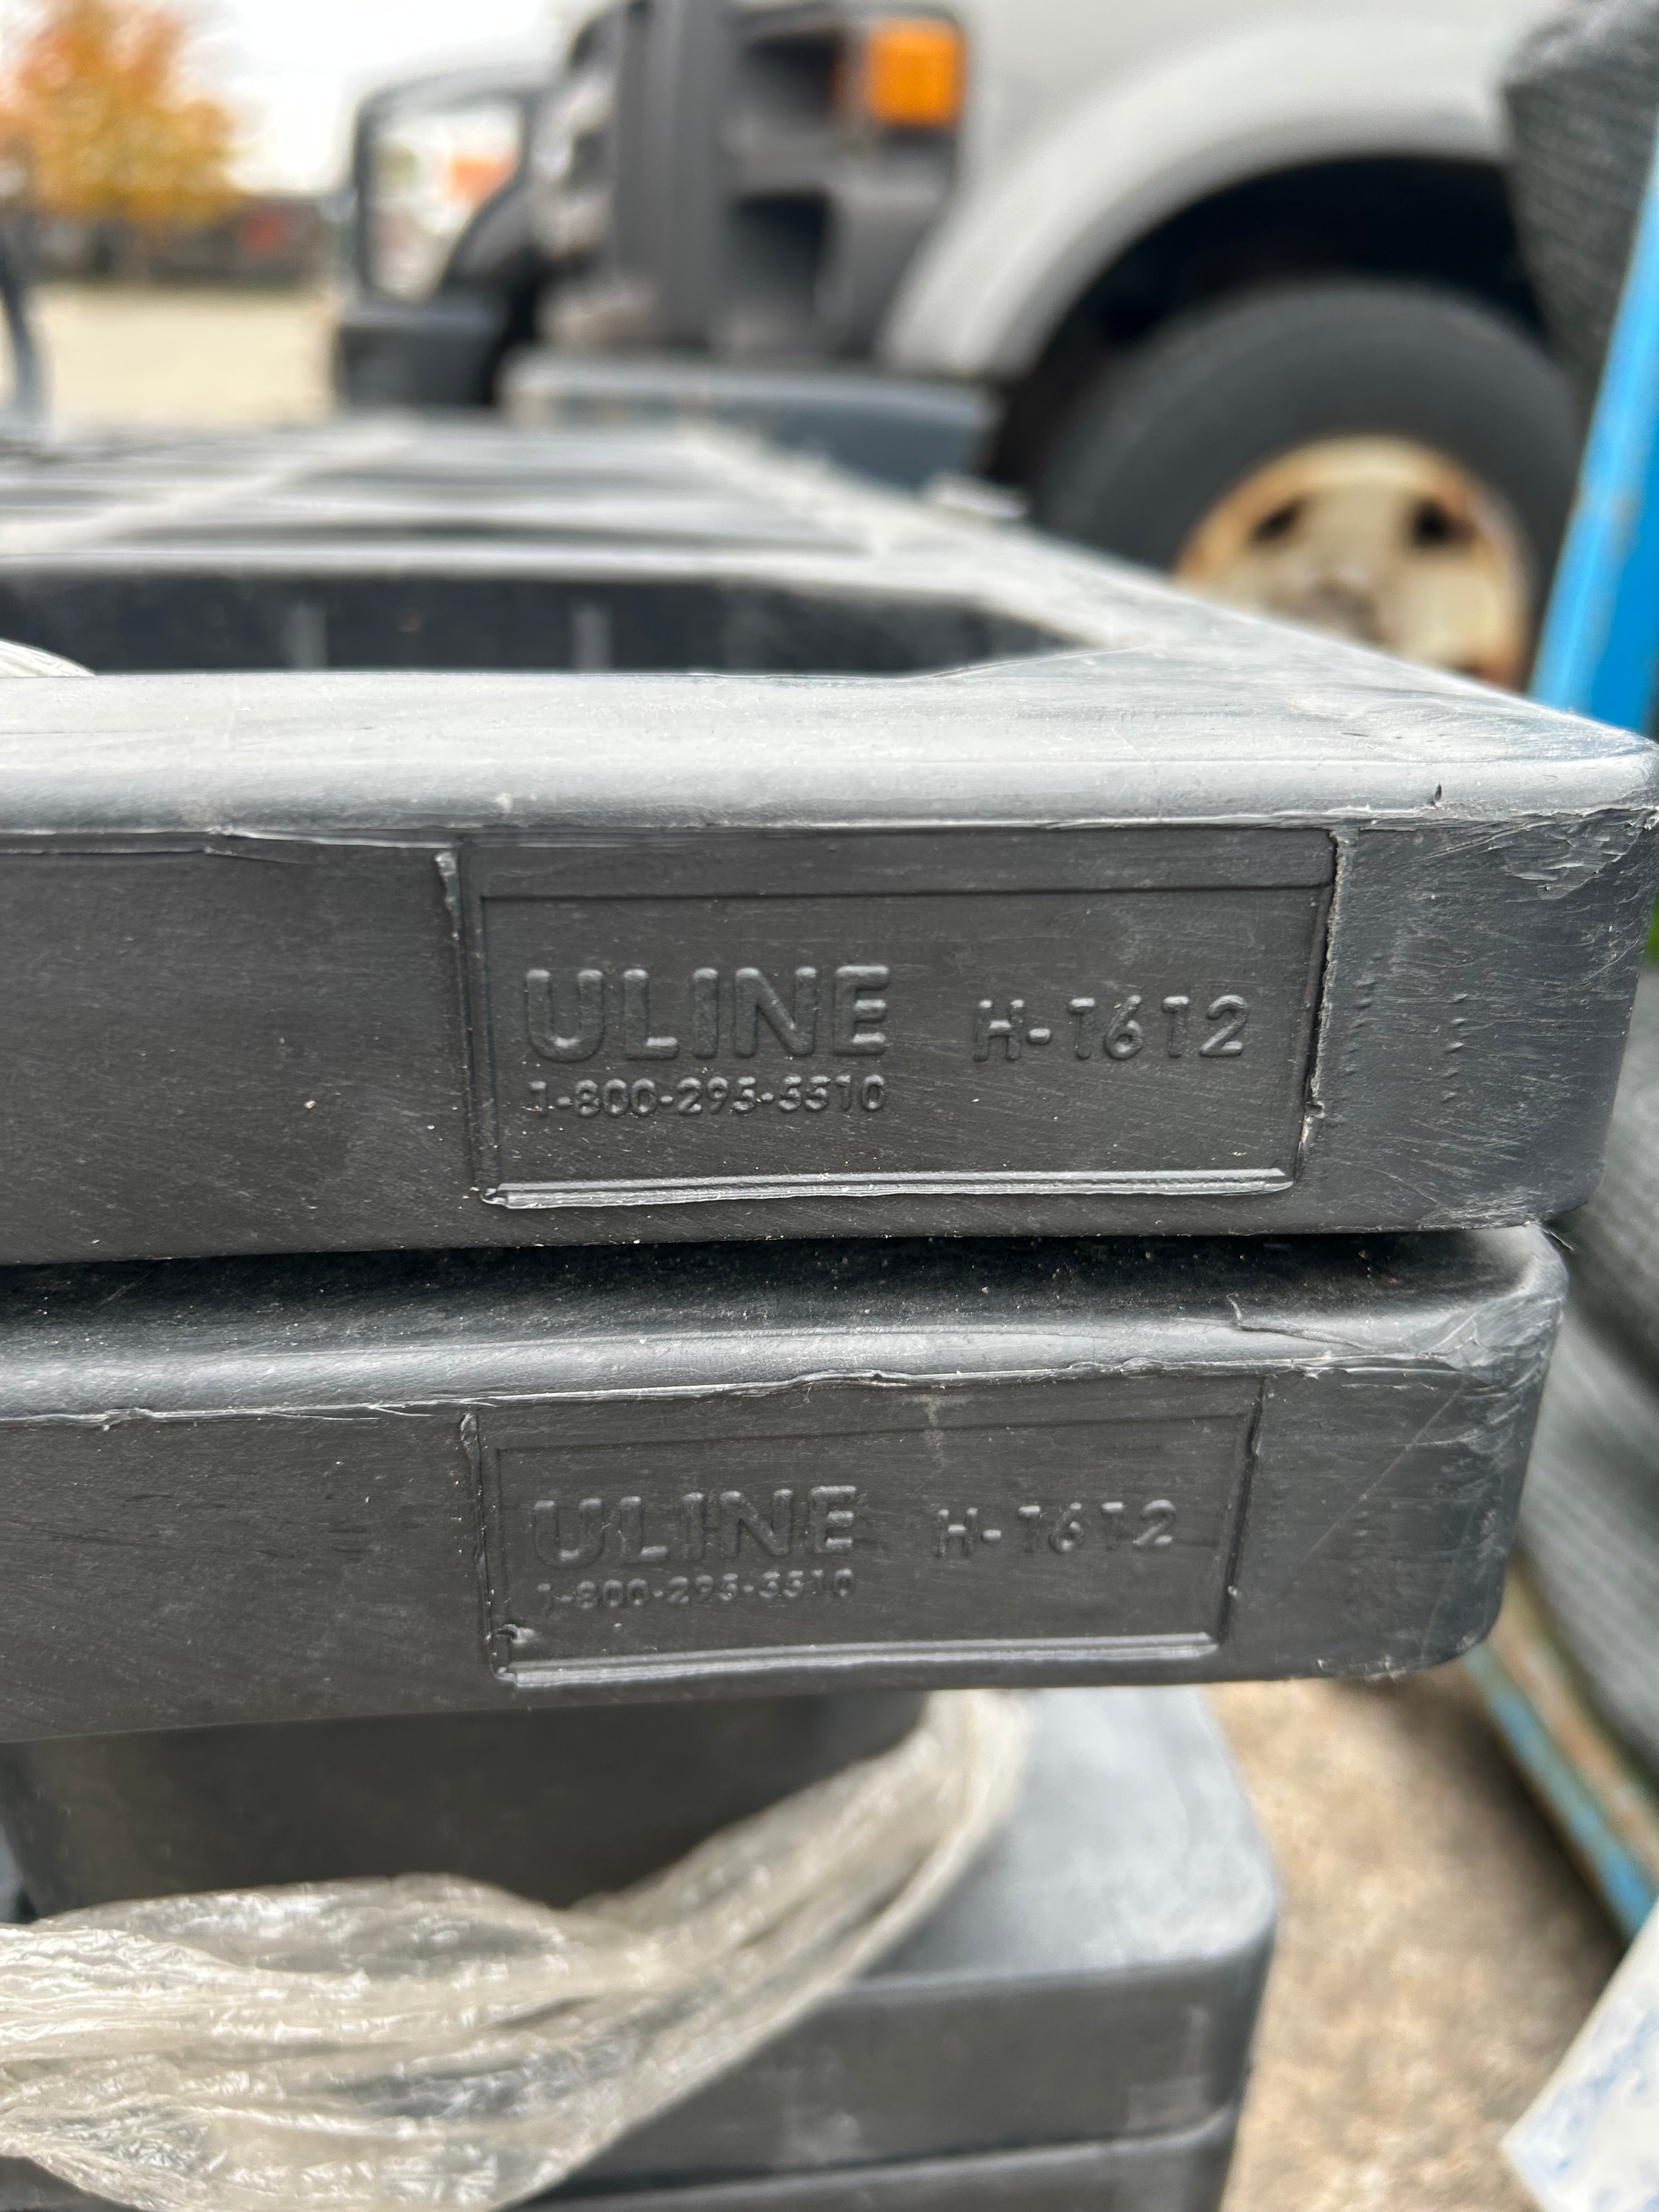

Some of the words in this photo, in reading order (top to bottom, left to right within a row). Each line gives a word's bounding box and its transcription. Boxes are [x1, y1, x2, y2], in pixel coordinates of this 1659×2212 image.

[524, 965, 890, 1062] ULINE
[974, 994, 1248, 1061] H-1612
[528, 1074, 885, 1117] 1-800-295-5510
[532, 1485, 857, 1567] ULINE
[935, 1499, 1176, 1558] H-1612
